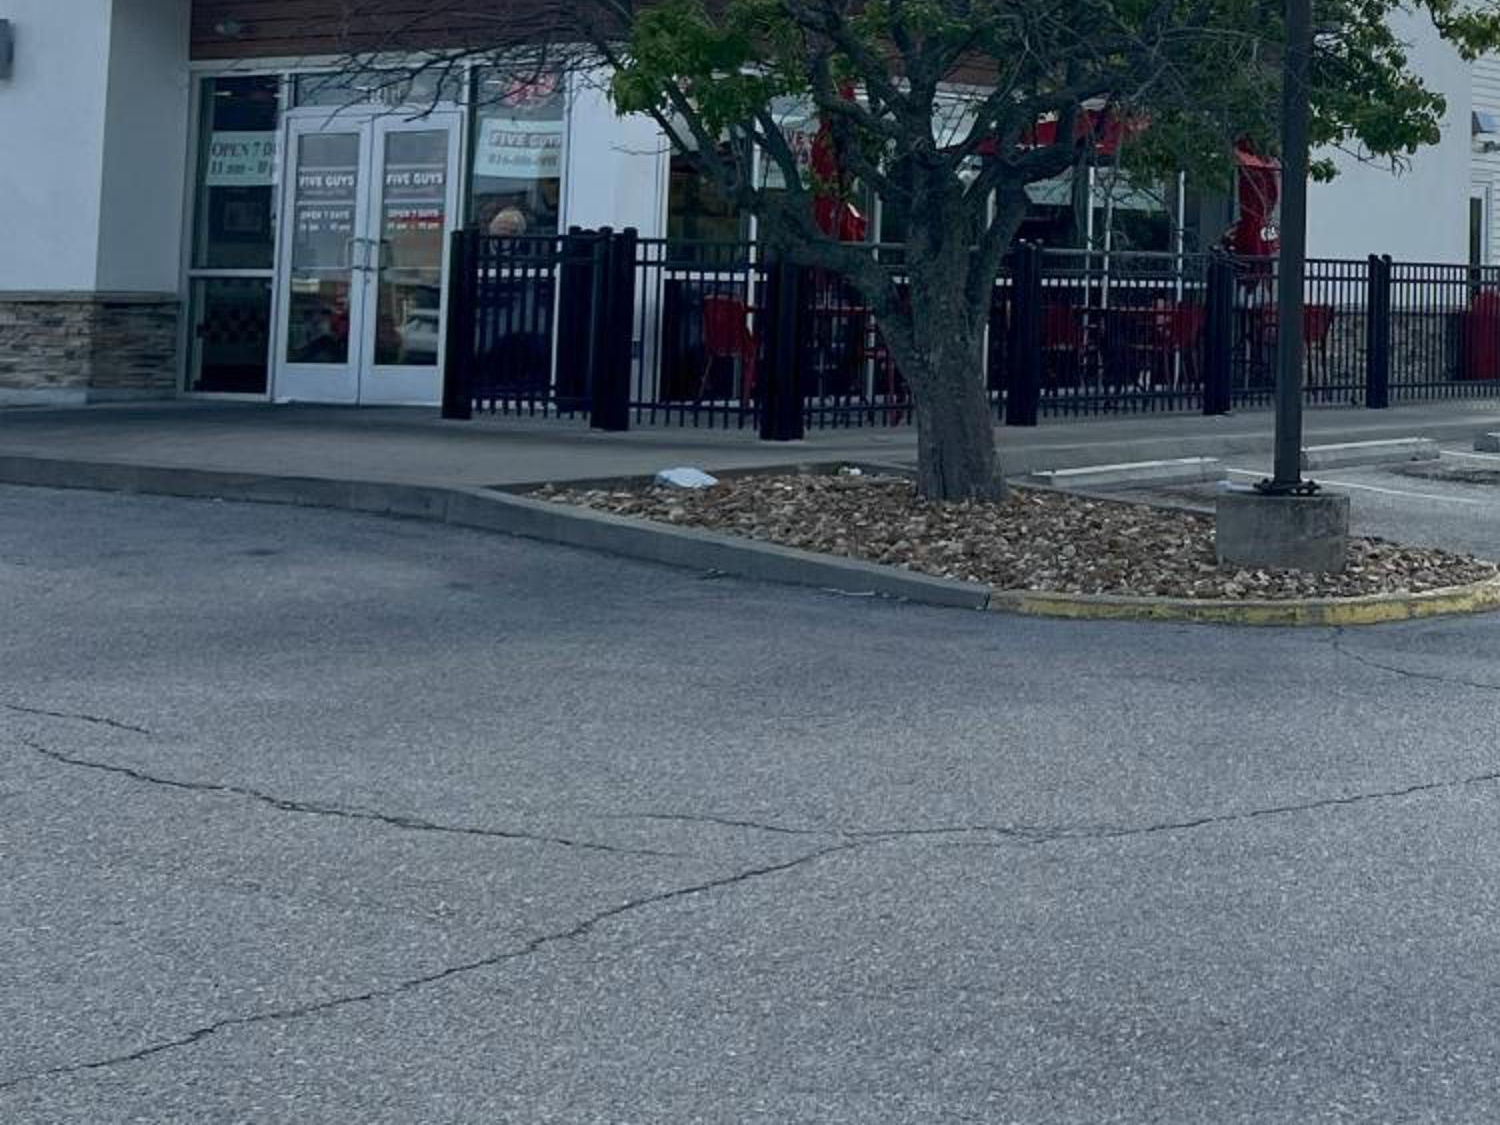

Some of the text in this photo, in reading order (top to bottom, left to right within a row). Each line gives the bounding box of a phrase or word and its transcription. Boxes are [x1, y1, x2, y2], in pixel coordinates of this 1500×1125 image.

[211, 140, 249, 157] OPEN
[299, 173, 355, 188] FIVE GUYS
[386, 172, 443, 187] FIVE GUYS
